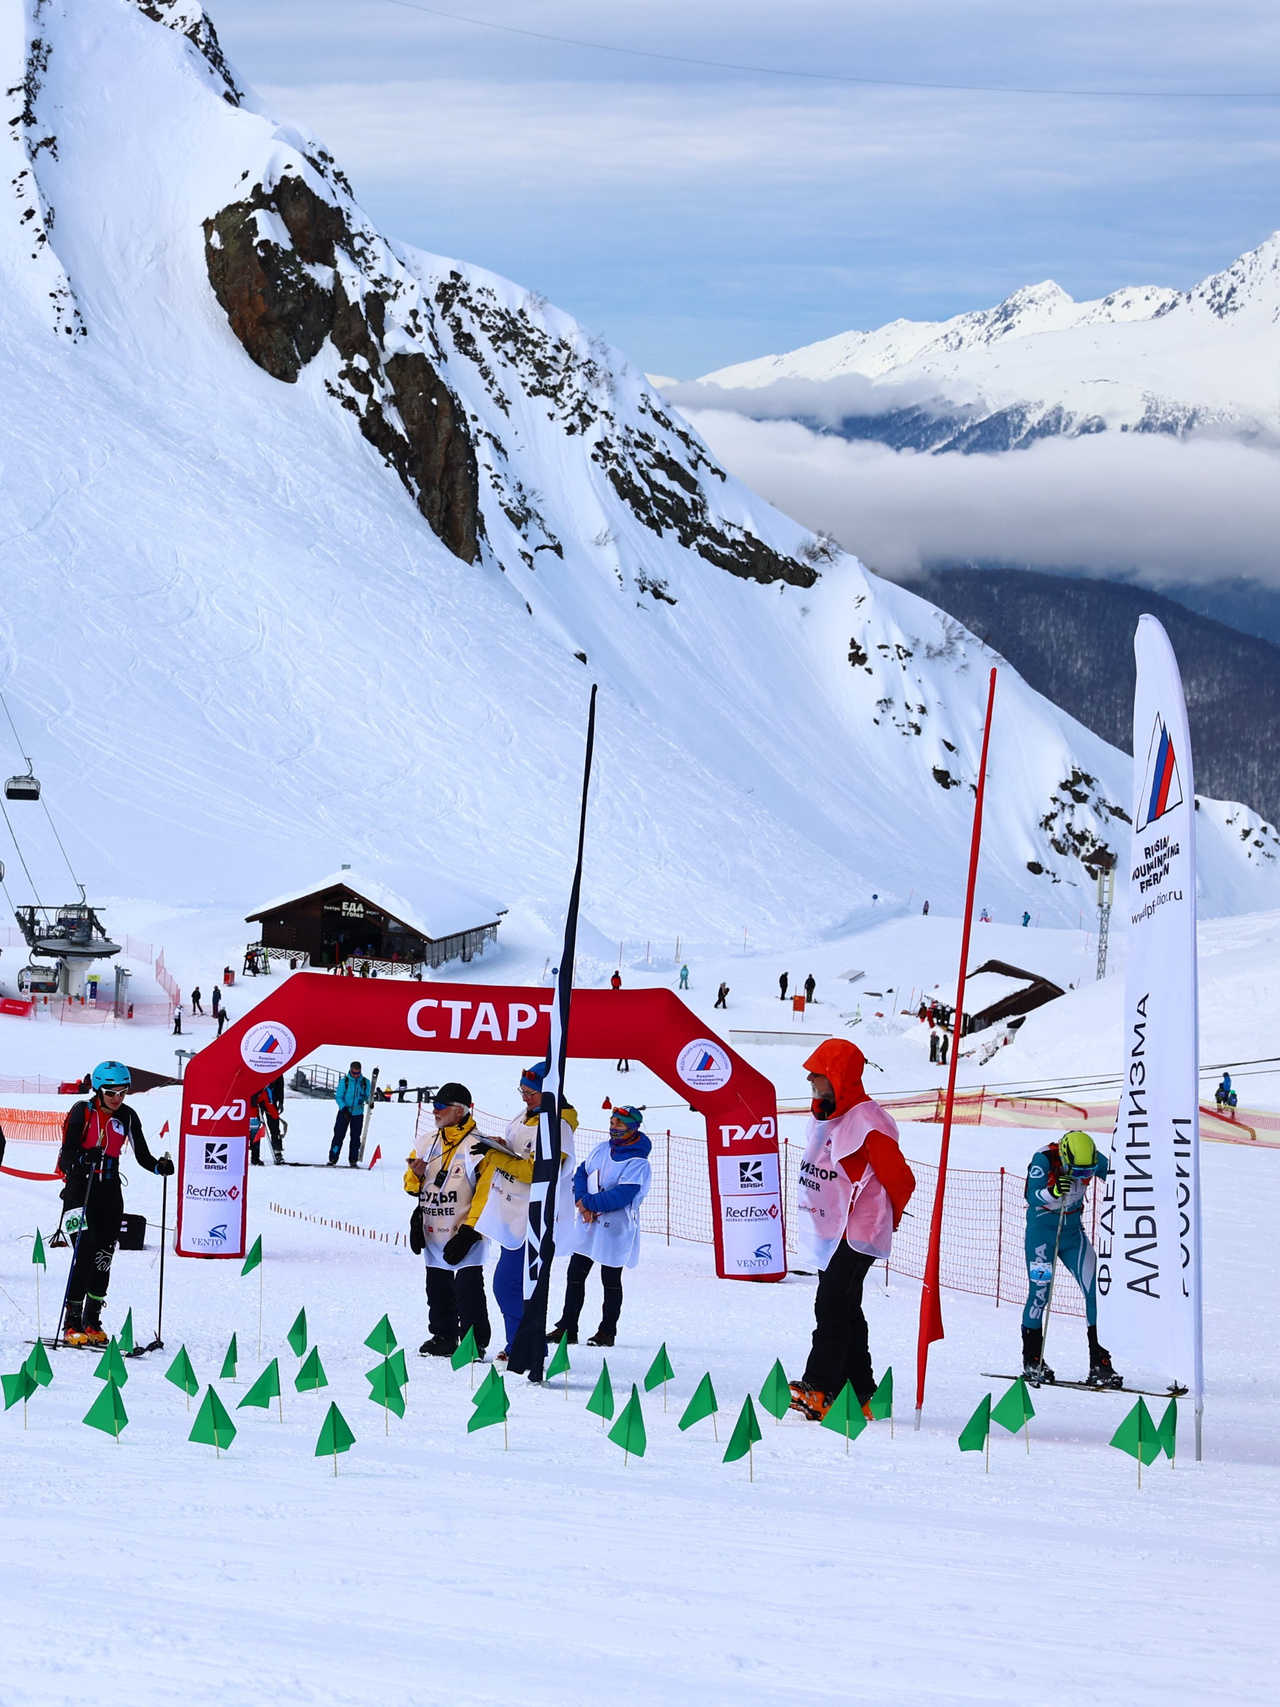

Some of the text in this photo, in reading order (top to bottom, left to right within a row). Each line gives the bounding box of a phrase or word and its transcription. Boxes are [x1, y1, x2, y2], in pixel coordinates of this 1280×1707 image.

[342, 901, 364, 913] ЕДА
[190, 1098, 247, 1126] РЖД
[718, 1116, 776, 1148] РЖД
[1123, 992, 1161, 1300] АЛЬПИНИЗМА
[186, 1184, 228, 1198] RedFox
[421, 1190, 458, 1207] СУДЬЯ
[422, 1207, 456, 1217] REFEREE
[725, 1206, 769, 1218] RedFox
[191, 1237, 223, 1247] VENTO
[736, 1259, 769, 1267] VENTO
[1037, 1270, 1045, 1279] 7
[1029, 1243, 1048, 1320] SCAPA
